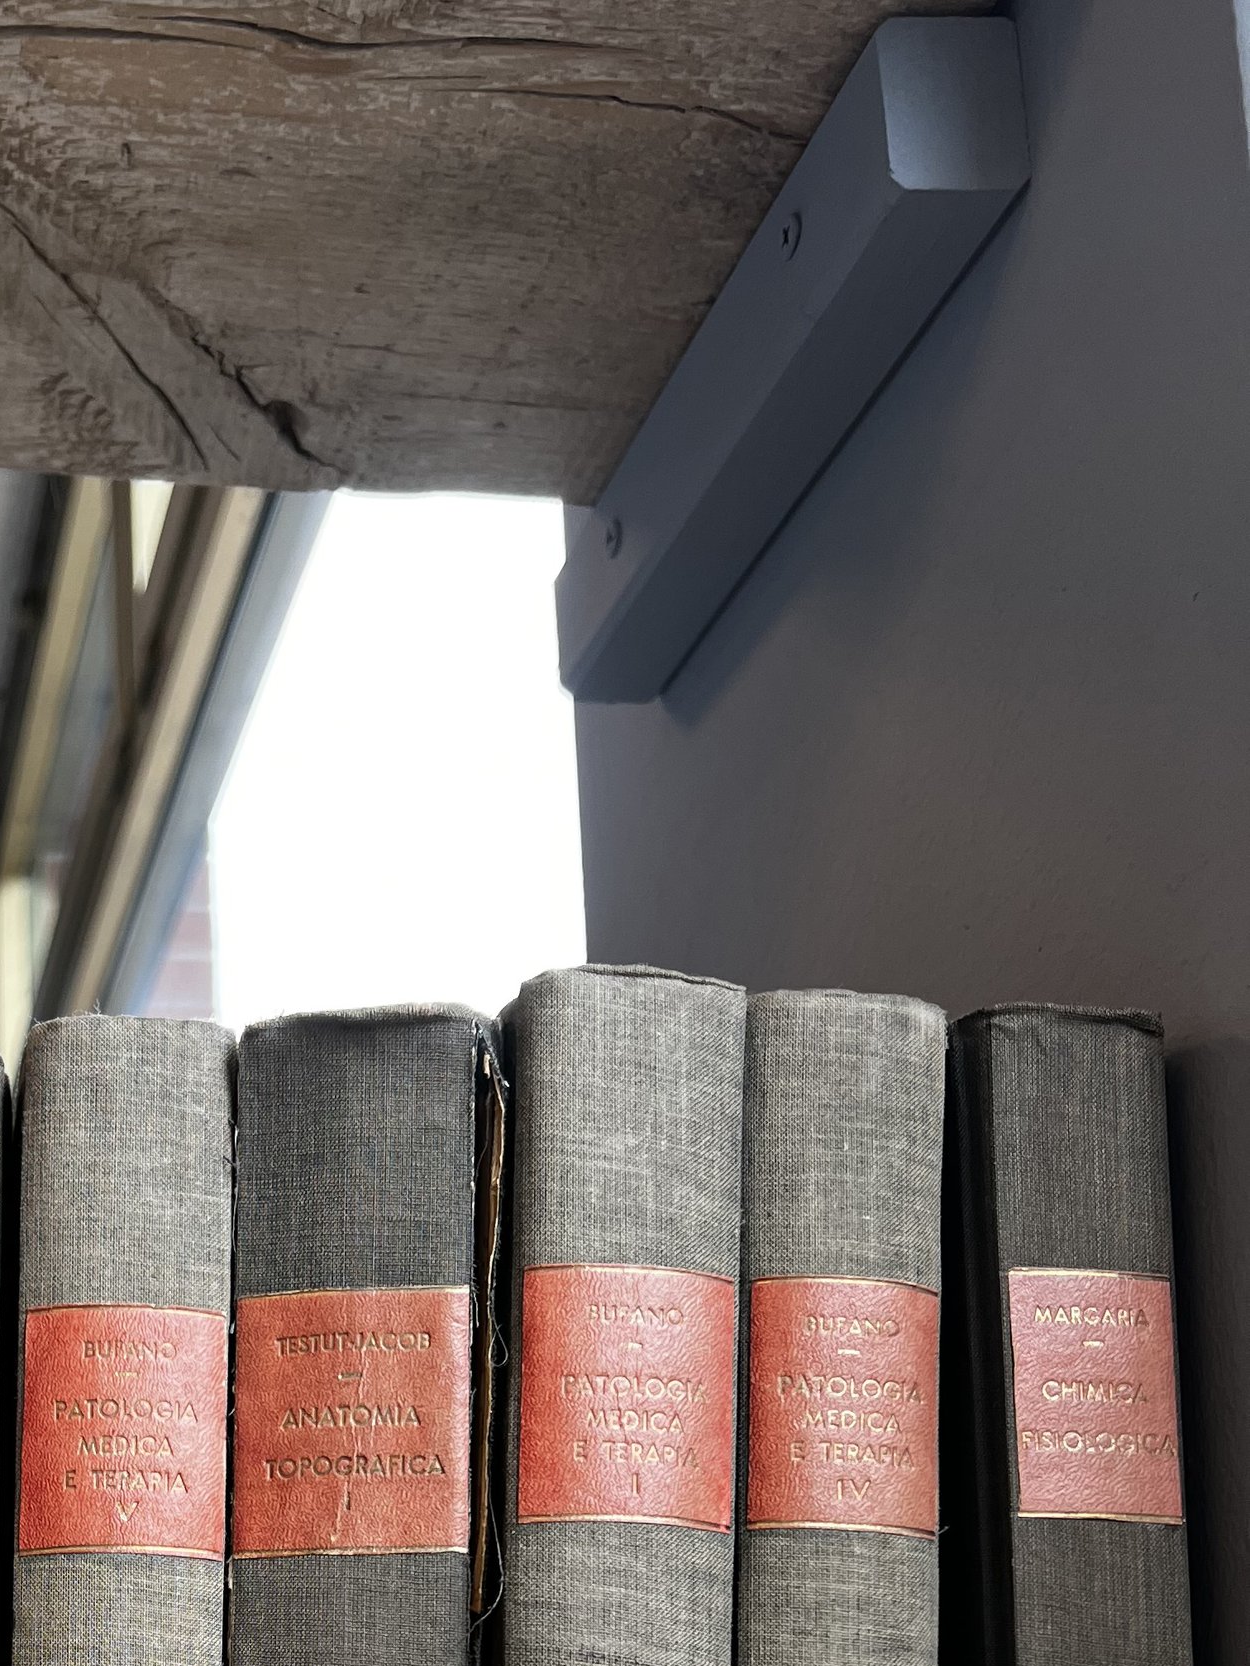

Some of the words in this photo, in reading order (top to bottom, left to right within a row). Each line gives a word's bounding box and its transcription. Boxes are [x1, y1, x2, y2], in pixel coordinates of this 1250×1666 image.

[588, 1304, 684, 1328] BUFANO
[806, 1315, 901, 1338] BUFANO
[1034, 1305, 1150, 1328] MARGARIA
[561, 1374, 708, 1402] PATOLOGIA
[776, 1375, 924, 1404] PATOLOGIA
[1042, 1380, 1150, 1403] CHIMICA
[53, 1398, 198, 1423] PATOLOGIA
[280, 1405, 421, 1431] ANATOMIA
[586, 1408, 685, 1433] MEDICA
[798, 1409, 901, 1433] MEDICA
[77, 1434, 174, 1457] MEDICA
[573, 1440, 587, 1462] E
[602, 1441, 701, 1468] TERAPIA
[790, 1442, 805, 1462] E
[819, 1442, 915, 1468] TERAPIA
[1021, 1430, 1177, 1457] FISIOLOGICA
[64, 1469, 77, 1490] E
[264, 1454, 446, 1482] TOPOGRAFICA
[836, 1478, 871, 1502] IV
